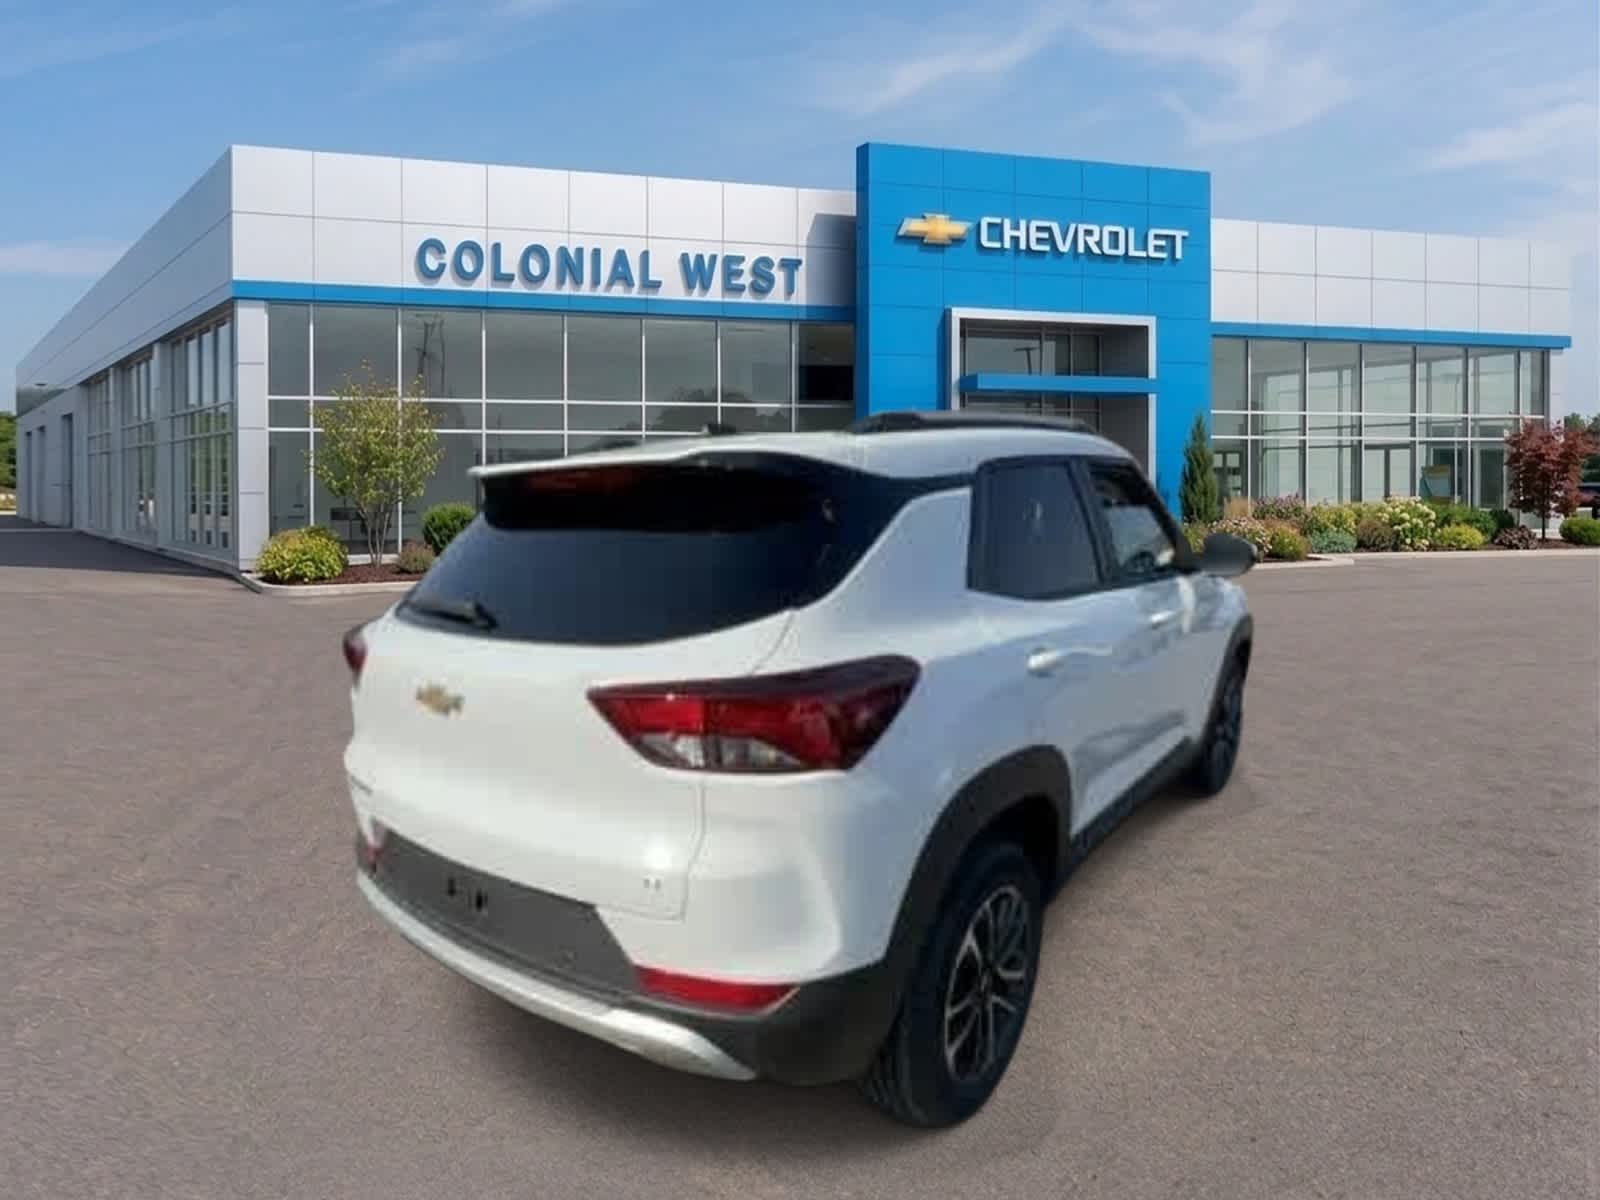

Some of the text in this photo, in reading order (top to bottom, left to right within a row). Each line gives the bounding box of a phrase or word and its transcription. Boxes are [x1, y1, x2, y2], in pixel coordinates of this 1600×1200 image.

[979, 216, 1189, 260] CHEVROLET
[417, 238, 803, 297] COLONIAL WEST
